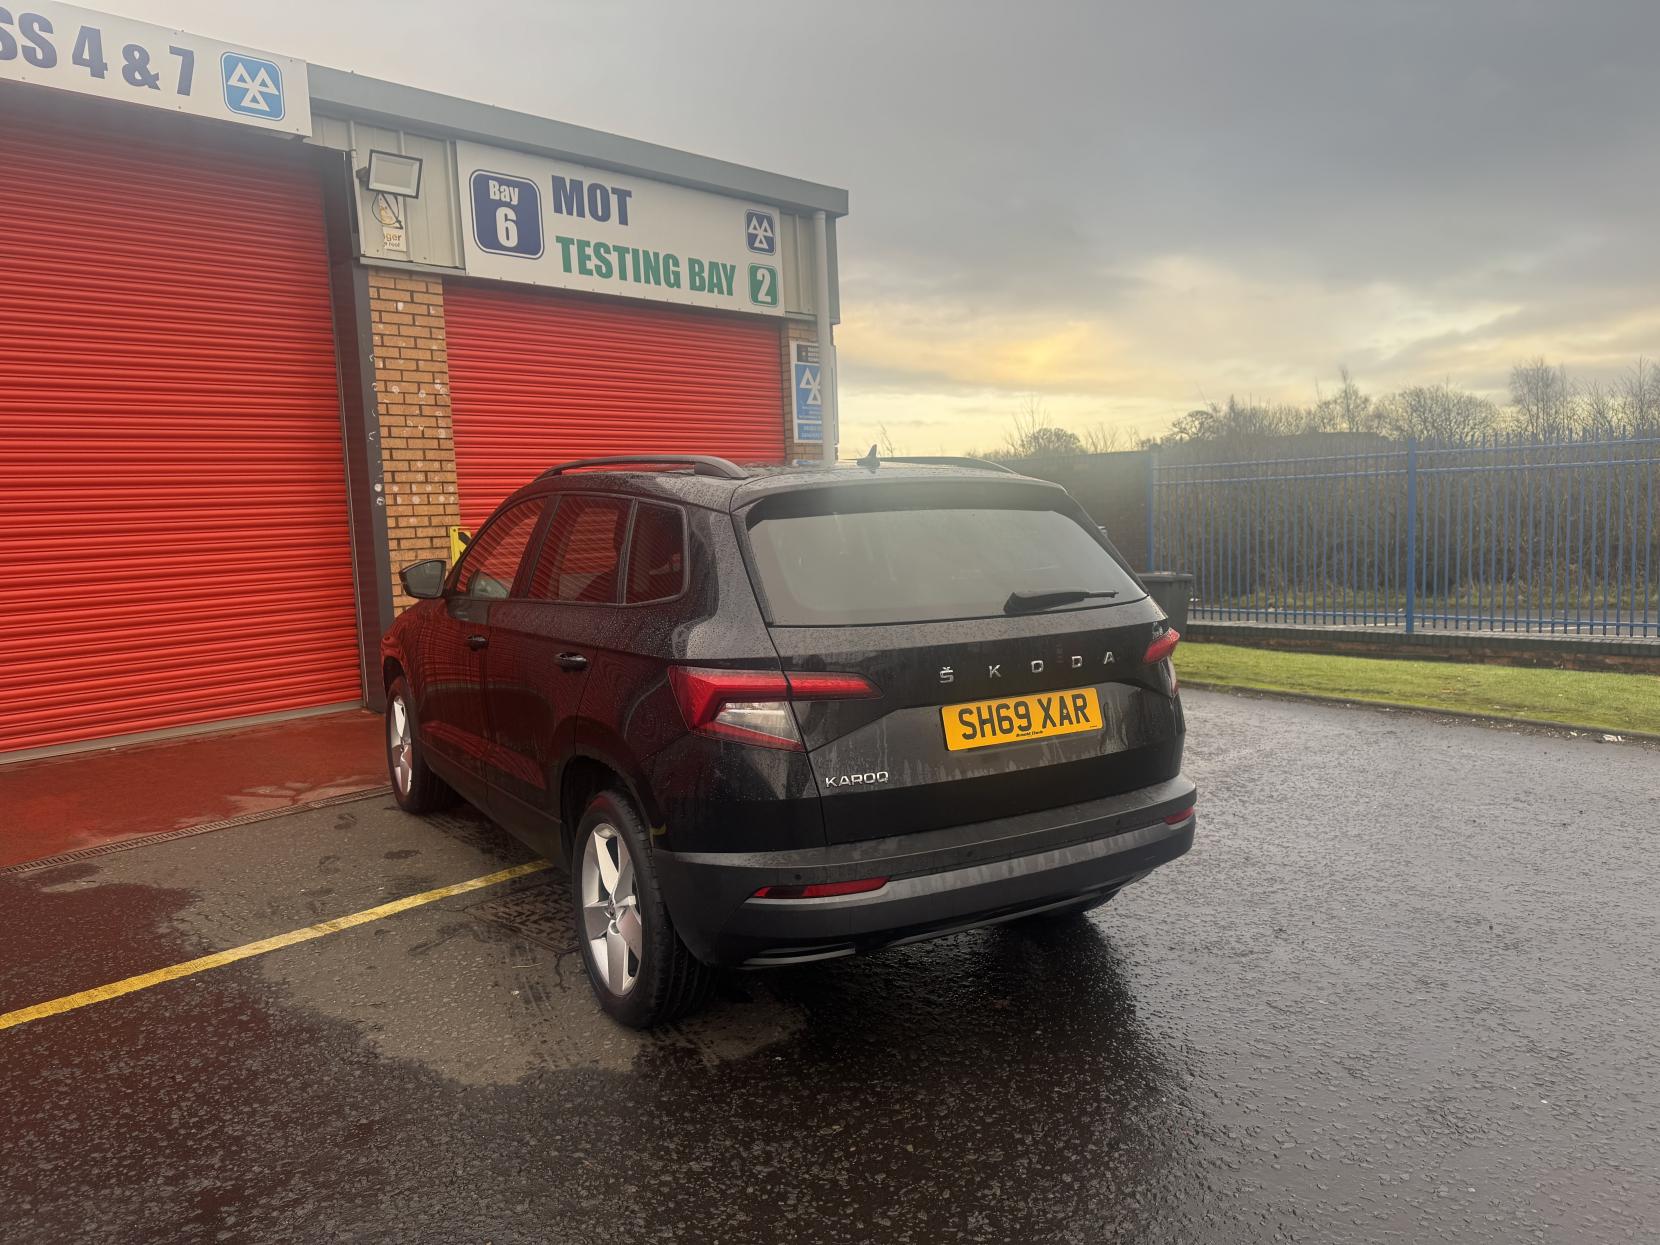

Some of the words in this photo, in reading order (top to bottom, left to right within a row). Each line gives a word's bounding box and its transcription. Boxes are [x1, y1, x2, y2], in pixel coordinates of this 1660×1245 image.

[72, 25, 108, 79] 4
[121, 43, 160, 90] &
[169, 45, 194, 96] 7
[488, 180, 519, 204] Bay
[551, 175, 632, 226] MOT
[495, 206, 518, 248] 6
[555, 236, 681, 289] TESTING
[687, 258, 736, 296] BAY
[756, 268, 772, 302] 2
[958, 700, 1032, 740] SH69
[1037, 693, 1091, 730] XAR
[825, 771, 889, 788] KAROQ
